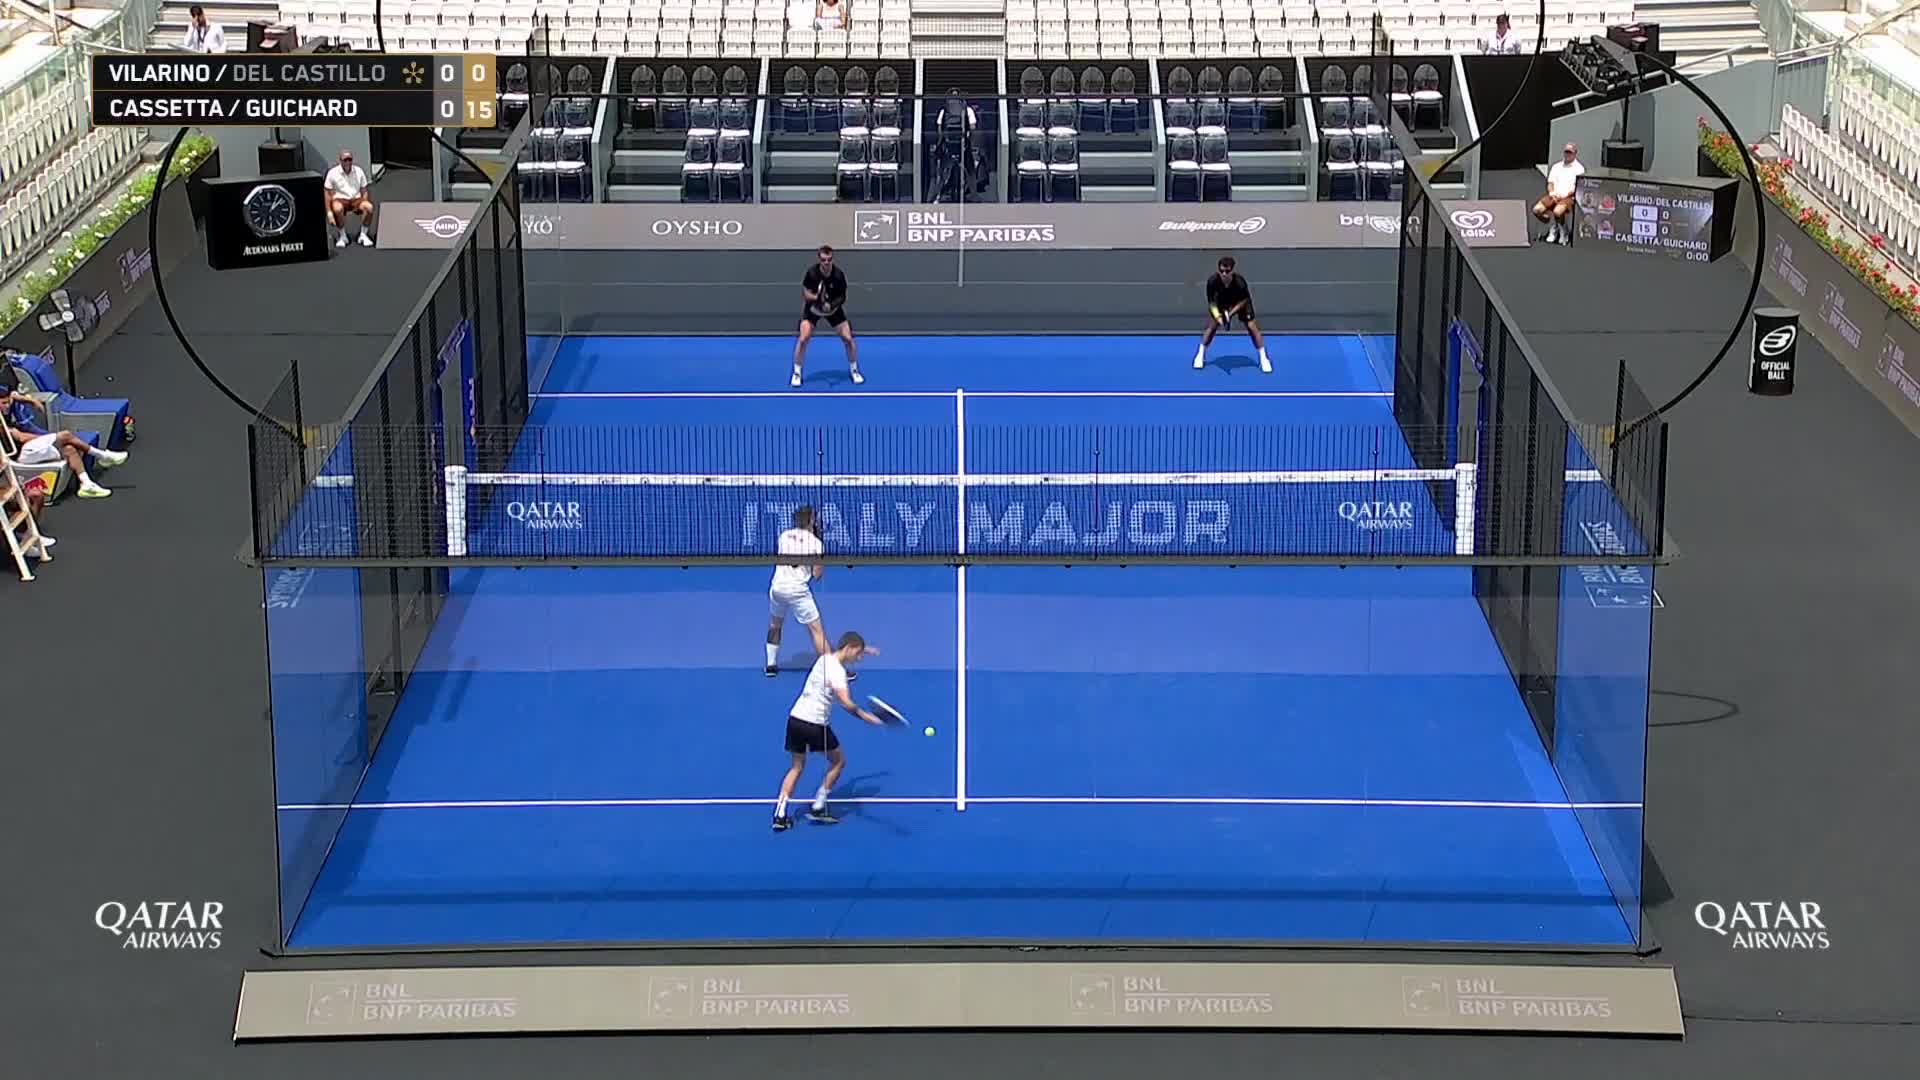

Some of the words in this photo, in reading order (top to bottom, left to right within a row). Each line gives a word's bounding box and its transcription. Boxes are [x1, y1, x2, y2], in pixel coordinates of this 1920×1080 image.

[908, 212, 953, 225] BNL
[435, 222, 458, 231] MINI
[652, 220, 743, 235] OYSHO
[1460, 228, 1496, 238] LGIDA
[908, 229, 954, 242] BNP
[960, 228, 1055, 242] PARIBAS
[1760, 361, 1791, 370] OFFICIAL
[1767, 371, 1785, 380] BALL
[507, 501, 581, 521] QATAR
[1338, 501, 1413, 521] QATAR
[527, 519, 583, 529] AIRWAYS
[743, 502, 937, 547] ITALY
[968, 500, 1231, 546] MAJOR
[1356, 518, 1413, 529] AIRWAYS
[95, 901, 224, 936] QATAR
[1695, 901, 1826, 936] QATAR
[122, 931, 222, 949] AIRWAYS
[1732, 931, 1830, 949] AIRWAYS
[365, 983, 414, 999] BNL
[703, 979, 744, 993] BNL
[1123, 976, 1168, 991] BNL
[1456, 979, 1504, 994] BNL
[363, 1003, 411, 1020] BNP
[417, 1002, 517, 1019] PARIBAS
[702, 999, 749, 1016] BNP
[755, 999, 850, 1015] PARIBAS
[1125, 998, 1171, 1013] BNP
[1176, 998, 1273, 1013] PARIBAS
[1458, 999, 1507, 1016] BNP
[1512, 999, 1612, 1018] PARIBAS
